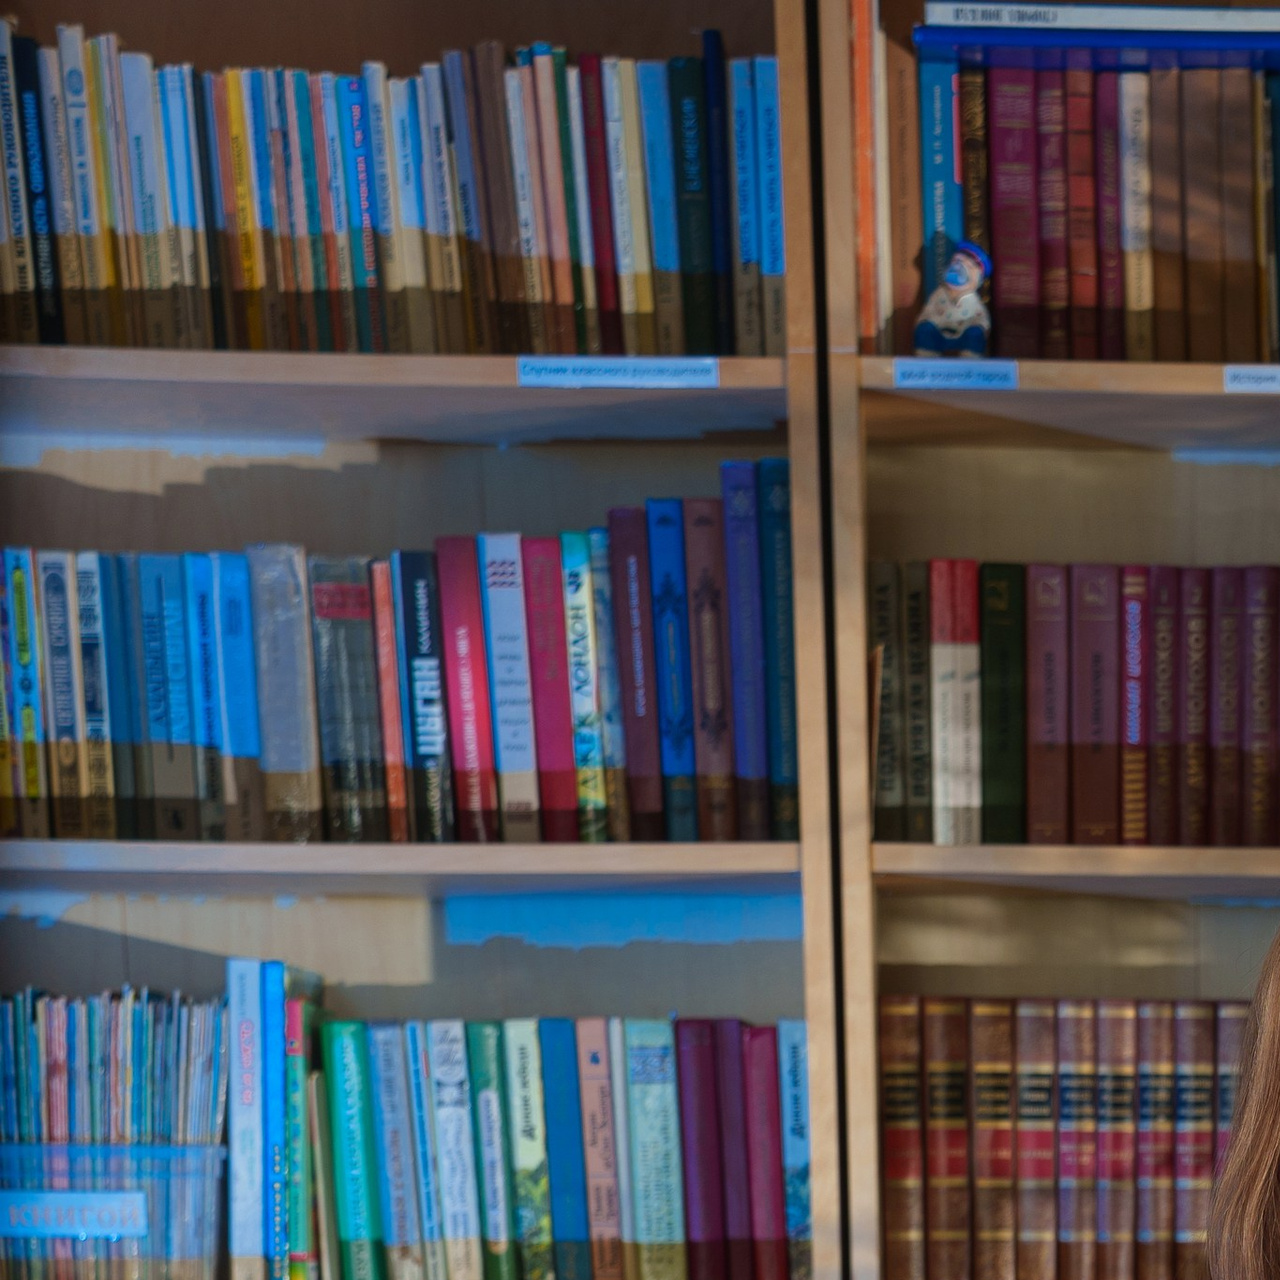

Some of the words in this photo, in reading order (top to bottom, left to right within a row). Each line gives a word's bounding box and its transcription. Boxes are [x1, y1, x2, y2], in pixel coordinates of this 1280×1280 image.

[1229, 372, 1277, 386] История
[567, 598, 593, 697] ЛОНДОН
[909, 590, 924, 675] ЦЕЛИНА
[1155, 617, 1172, 734] ШОЛОХОВ
[1188, 617, 1205, 734] ШОЛОХОВ
[1222, 617, 1237, 734] ШОЛОХОВ
[1252, 617, 1269, 734] ШОЛОХОВ
[412, 656, 443, 756] ЦЫГАН
[573, 711, 601, 794] ДЖЕК
[911, 682, 926, 797] ПОДНЯТАЯ
